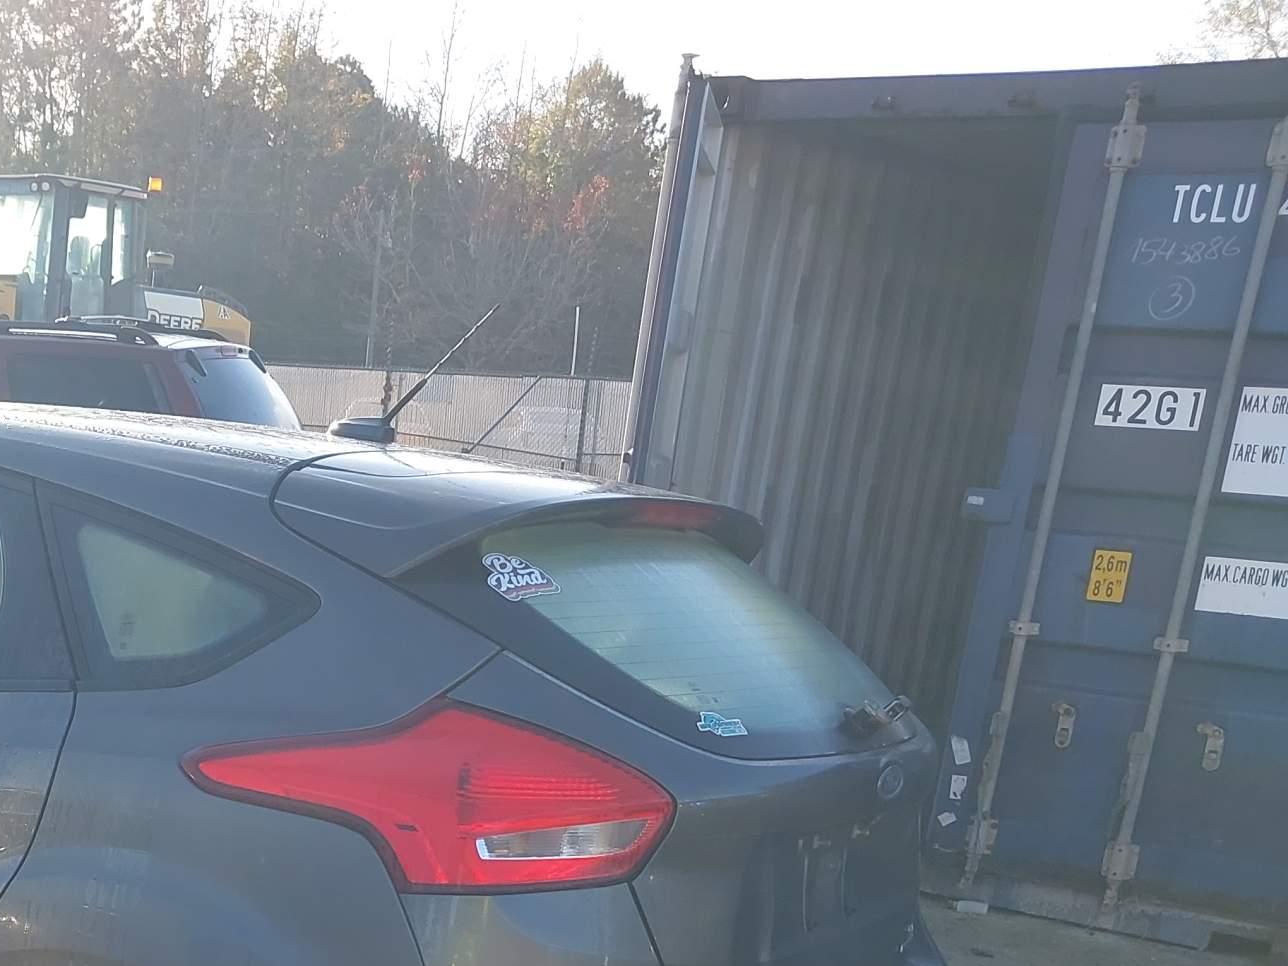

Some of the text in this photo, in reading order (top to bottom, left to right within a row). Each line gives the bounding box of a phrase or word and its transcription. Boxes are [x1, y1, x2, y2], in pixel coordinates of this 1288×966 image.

[1173, 184, 1256, 223] TCLU
[1102, 388, 1201, 428] 42G1
[1232, 443, 1259, 463] TARE
[486, 555, 525, 573] Be
[490, 568, 547, 592] Kind
